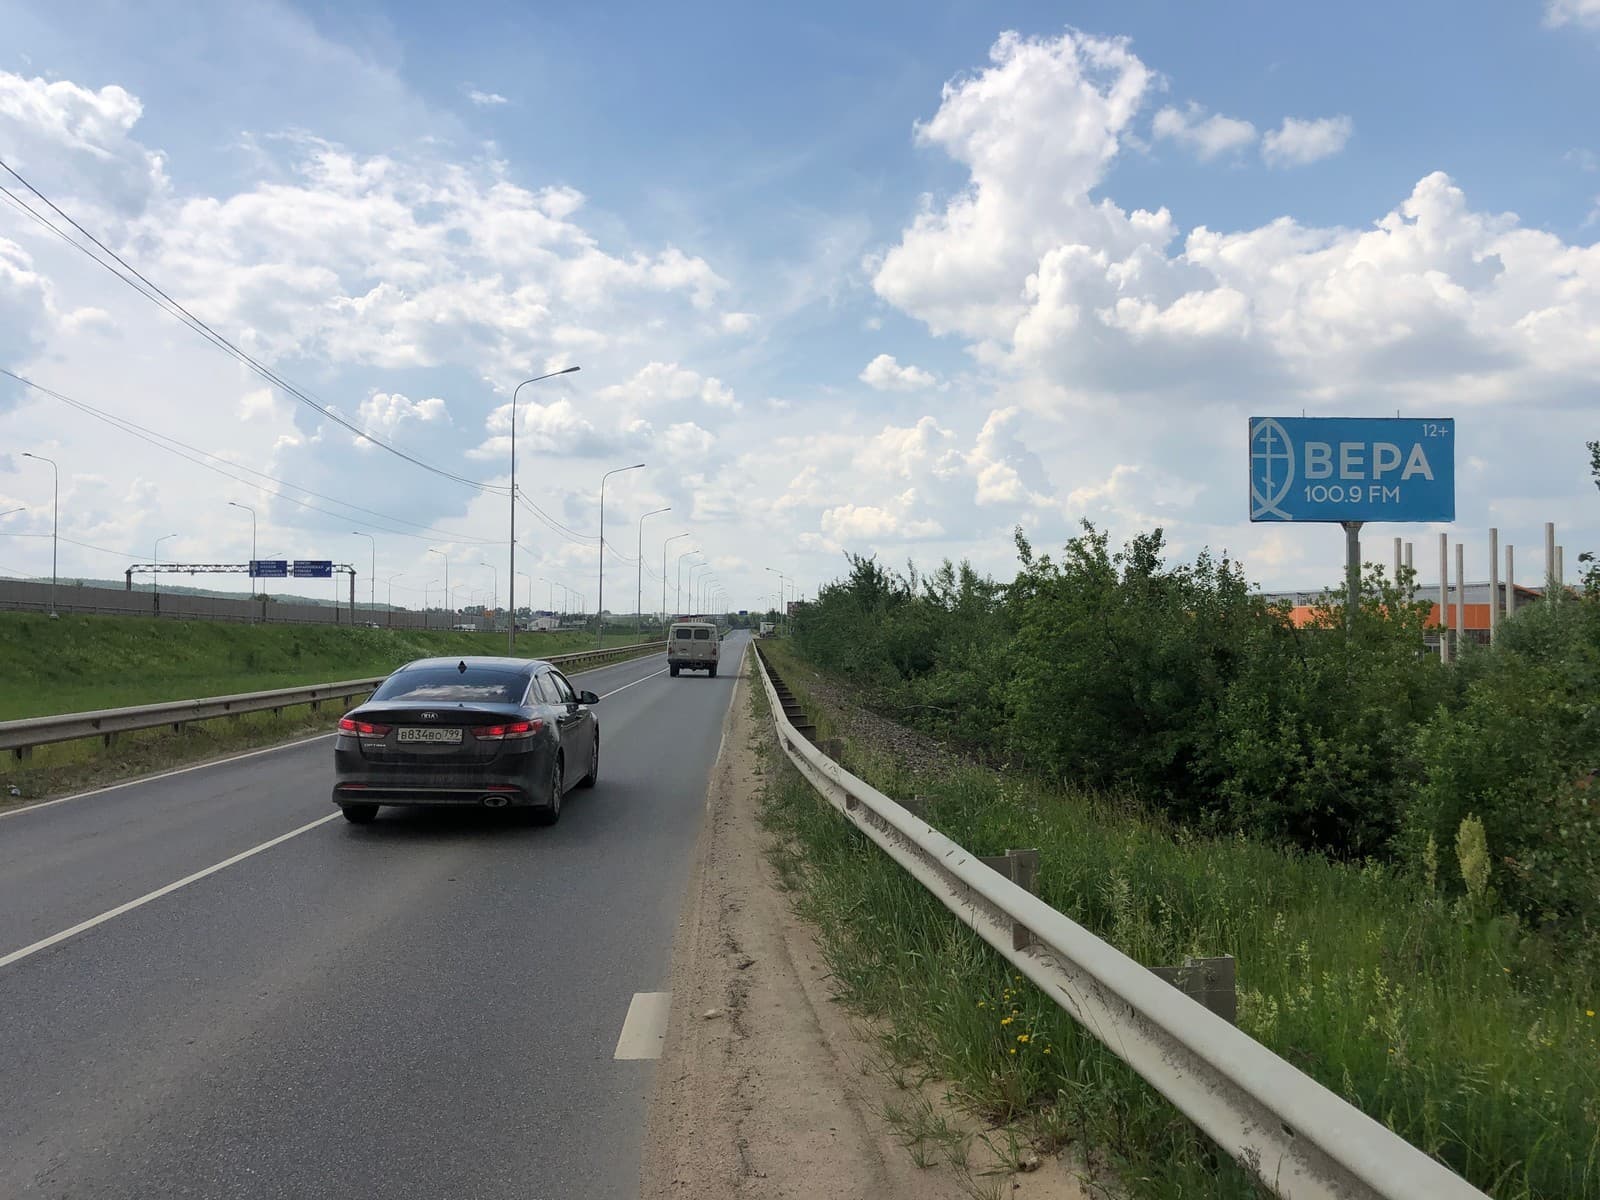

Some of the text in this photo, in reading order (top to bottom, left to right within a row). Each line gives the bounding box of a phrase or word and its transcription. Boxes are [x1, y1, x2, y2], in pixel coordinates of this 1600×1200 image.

[1422, 423, 1449, 437] 12+
[1304, 441, 1434, 481] ВЕРА
[1304, 485, 1400, 503] 100.9 FM
